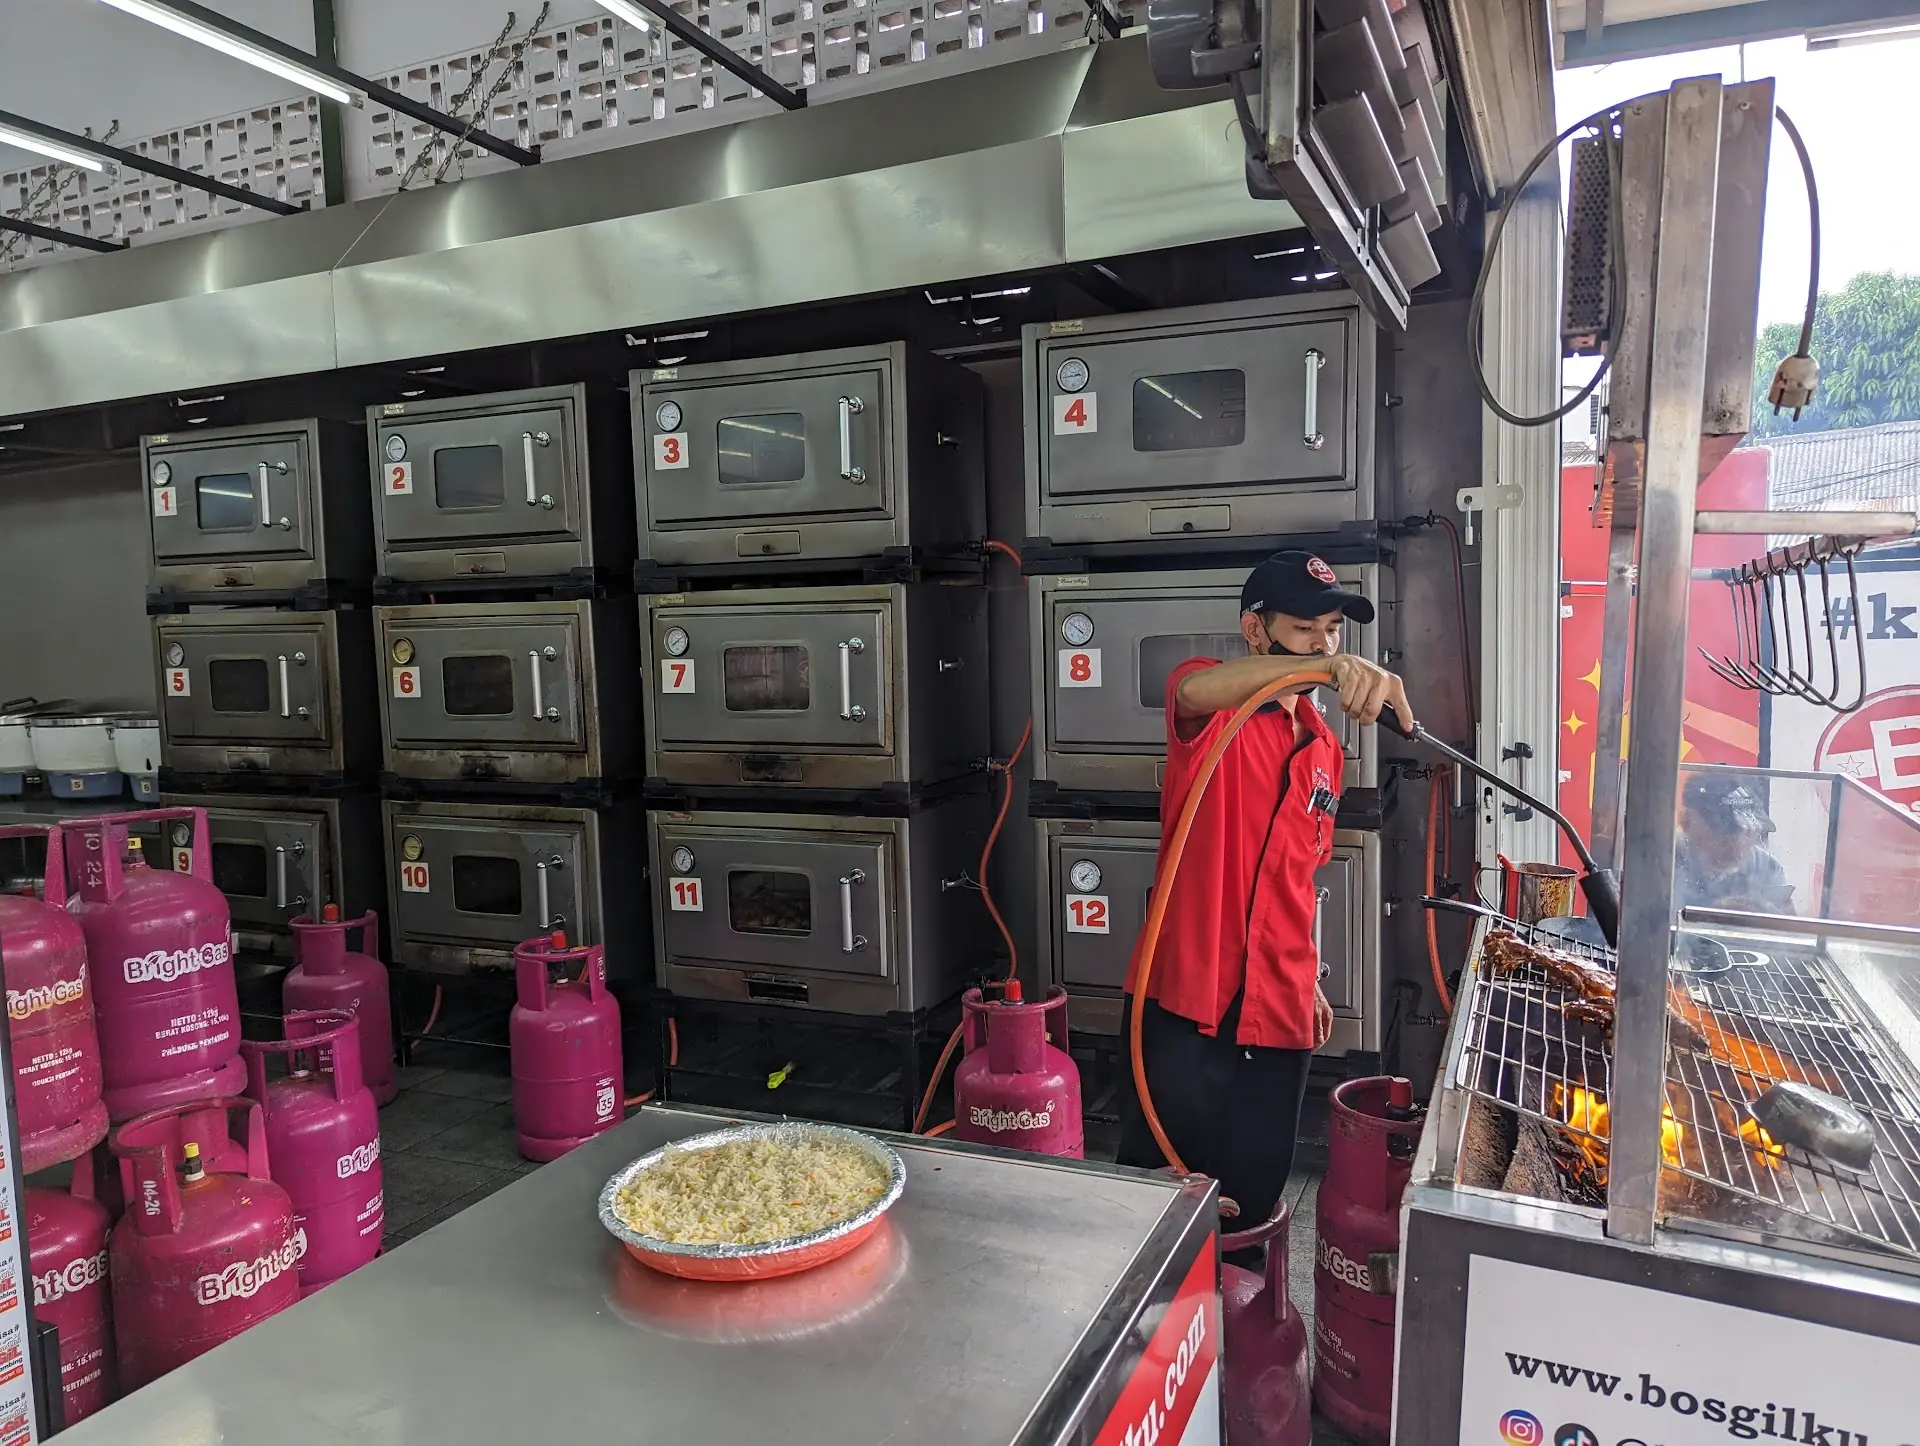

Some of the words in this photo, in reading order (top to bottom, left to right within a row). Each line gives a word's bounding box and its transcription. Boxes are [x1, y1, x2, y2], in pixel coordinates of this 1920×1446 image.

[1064, 399, 1088, 427] 4
[663, 437, 680, 464] 3
[392, 467, 405, 490] 2
[160, 491, 169, 511] 1
[670, 664, 686, 688] 7
[1069, 654, 1092, 682] 8
[173, 672, 185, 692] 5
[400, 671, 414, 694] 6
[178, 851, 190, 872] 9
[403, 865, 428, 889] 10
[674, 882, 698, 906] 11
[1069, 900, 1107, 928] 12
[124, 947, 200, 983] Bright
[199, 941, 229, 968] Gas
[6, 986, 54, 1020] ight
[52, 980, 84, 1005] Gas
[155, 1026, 180, 1039] BERAT
[18, 1064, 39, 1075] BERAT
[600, 1097, 612, 1111] 35
[970, 1106, 1018, 1133] Bright
[1017, 1109, 1051, 1130] Gas
[197, 1250, 281, 1305] Bright
[1329, 1246, 1371, 1292] Gas
[1504, 1352, 1920, 1446] www.bosgilku
